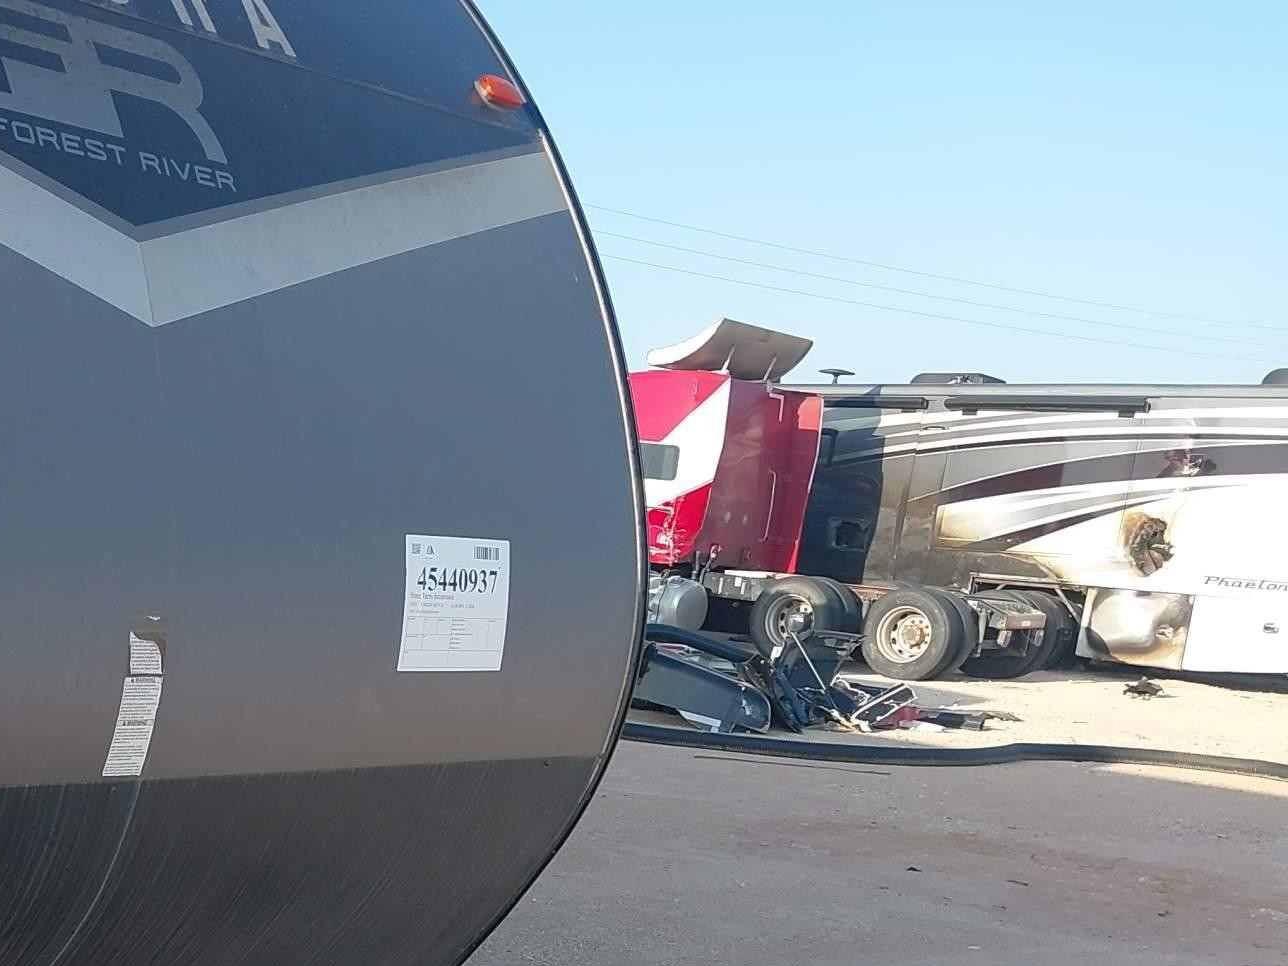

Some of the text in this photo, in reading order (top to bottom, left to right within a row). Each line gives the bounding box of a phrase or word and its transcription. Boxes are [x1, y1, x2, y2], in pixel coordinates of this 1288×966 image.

[139, 151, 237, 193] RIVER
[417, 566, 499, 594] 45440937
[1203, 575, 1288, 592] Phaeton
